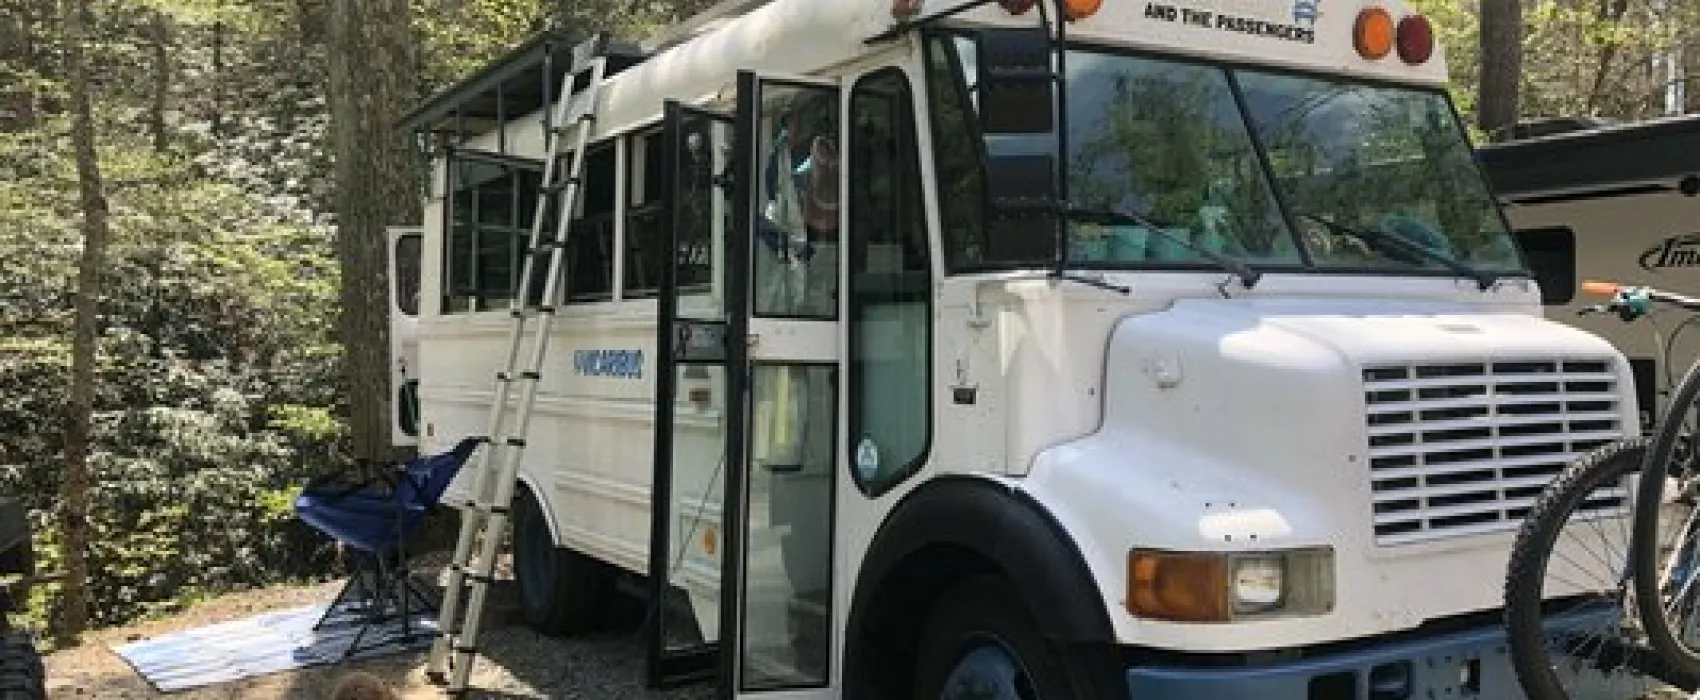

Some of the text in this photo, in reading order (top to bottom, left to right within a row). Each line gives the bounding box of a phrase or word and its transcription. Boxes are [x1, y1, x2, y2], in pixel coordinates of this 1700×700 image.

[1144, 2, 1315, 44] AND THE PASSENGERS
